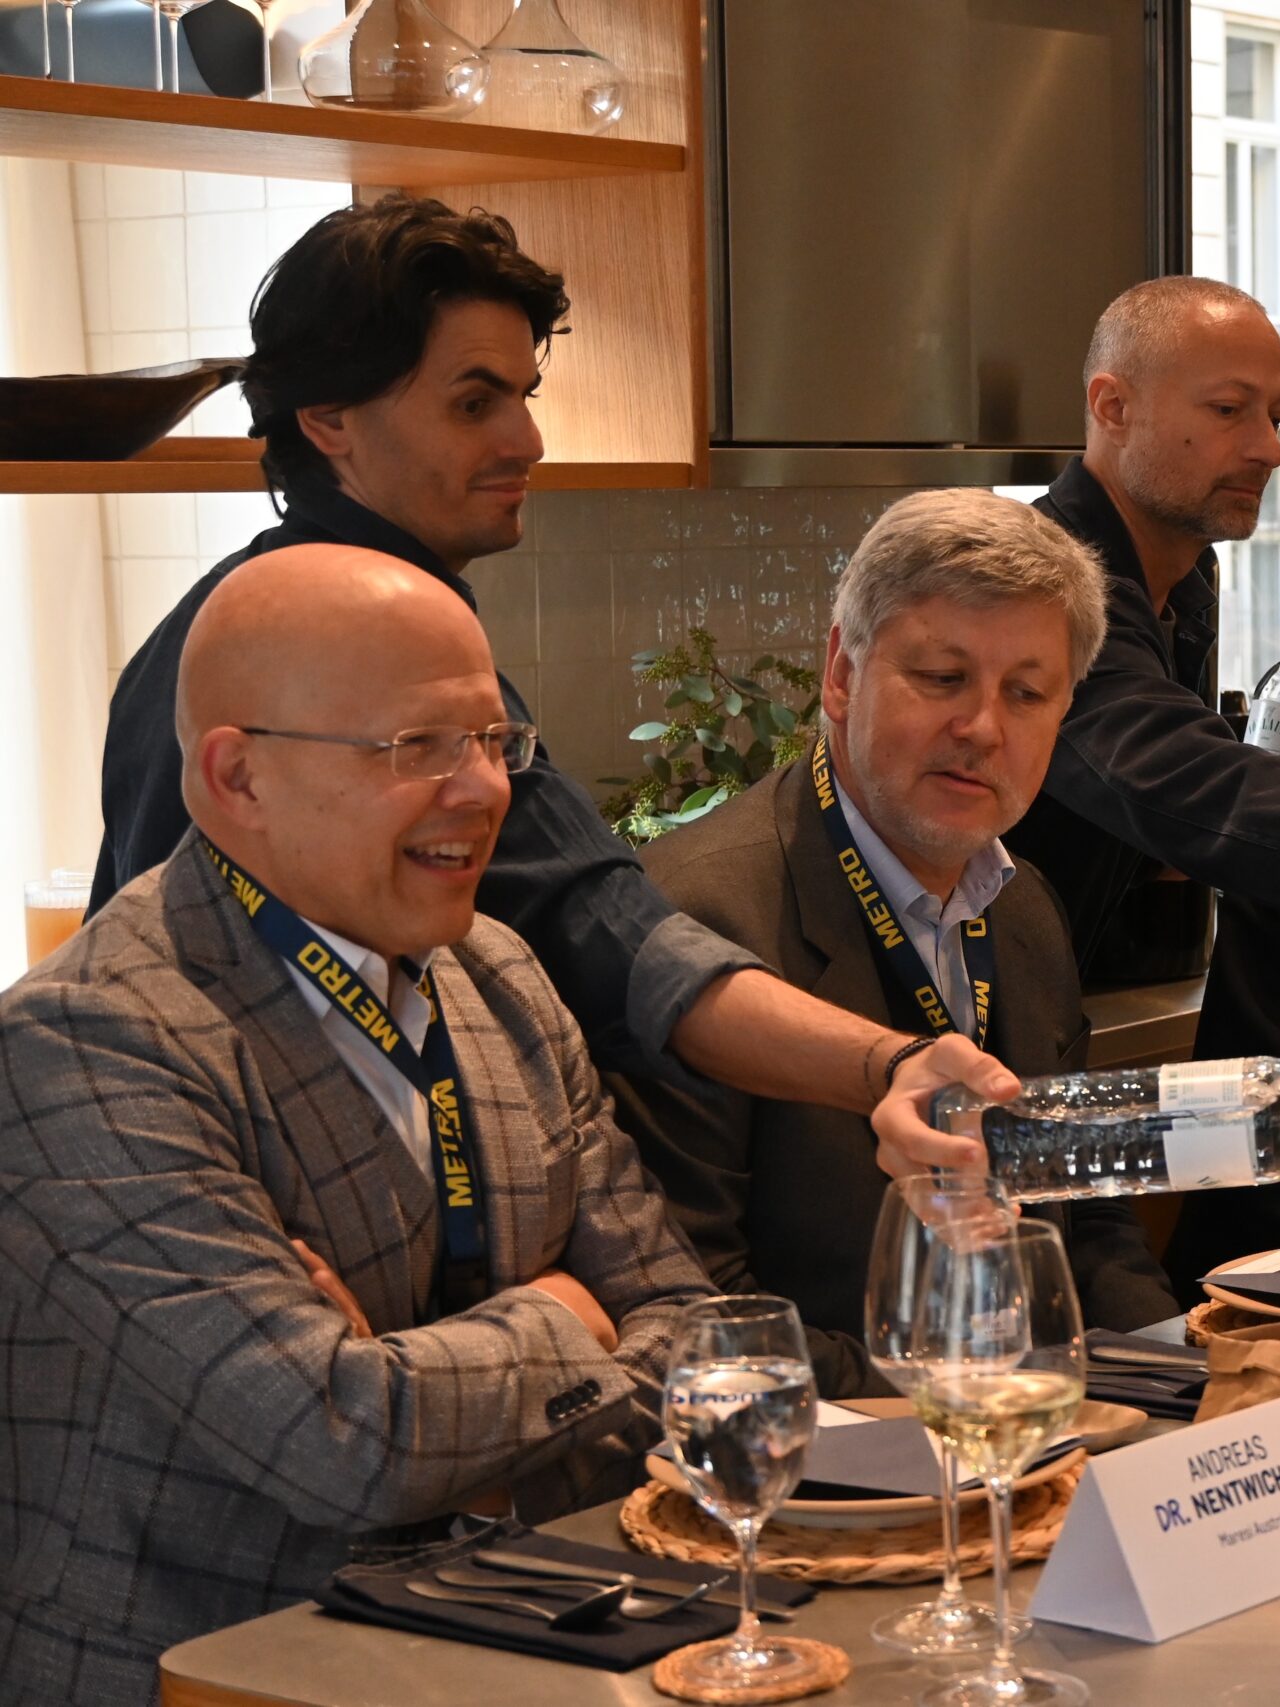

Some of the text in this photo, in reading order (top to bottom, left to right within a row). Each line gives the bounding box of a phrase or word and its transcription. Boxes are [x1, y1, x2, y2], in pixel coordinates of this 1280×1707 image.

[838, 847, 904, 950] METRO
[297, 941, 400, 1053] METRO
[1187, 1434, 1268, 1482] ANDREAS
[1154, 1498, 1192, 1532] DR.
